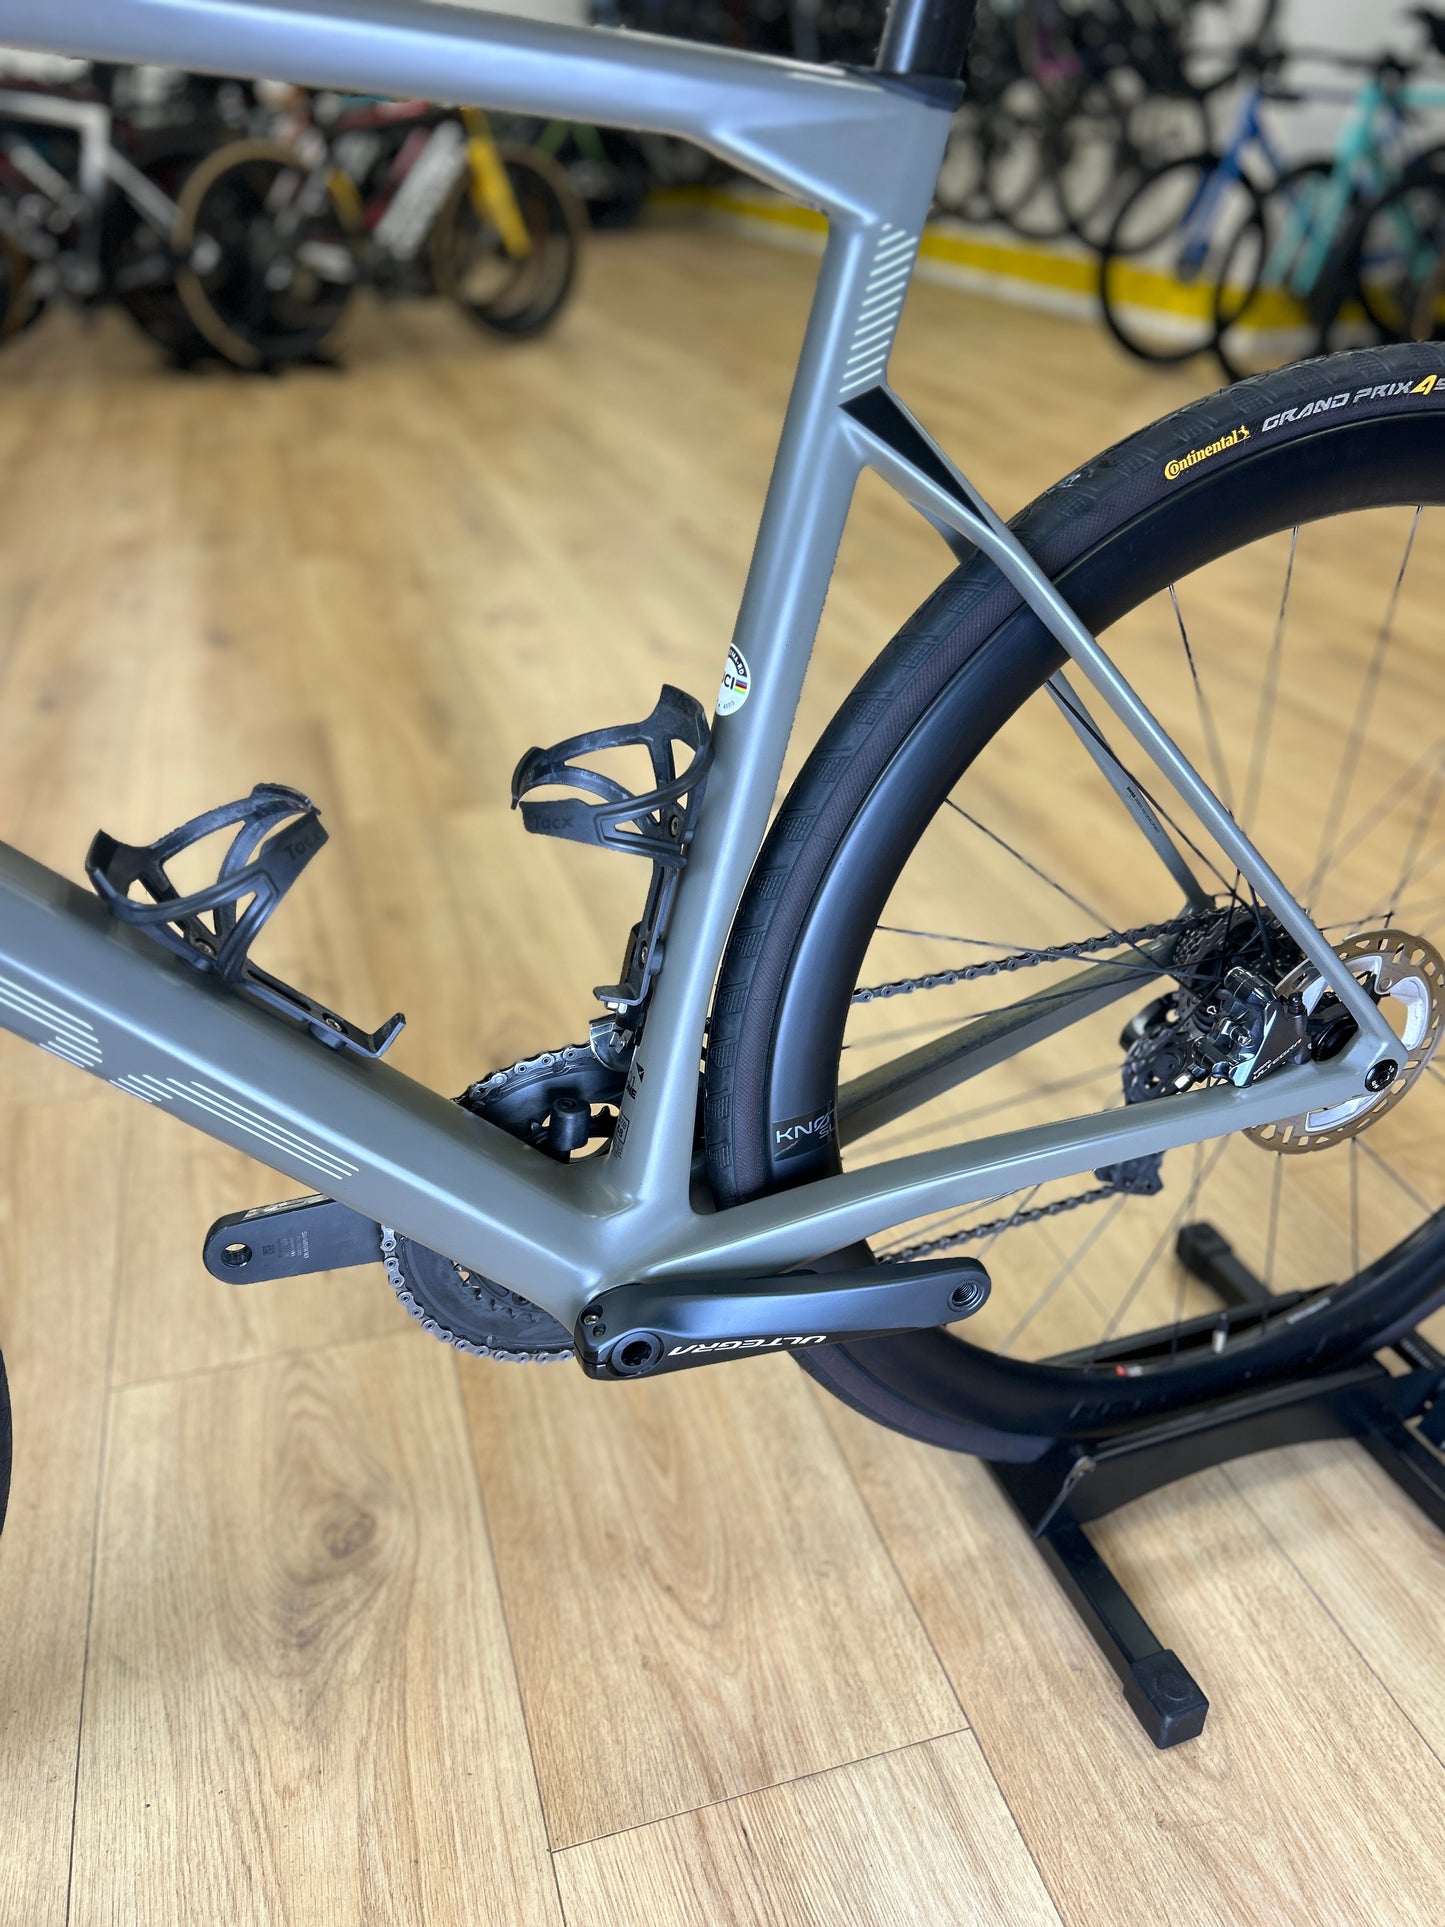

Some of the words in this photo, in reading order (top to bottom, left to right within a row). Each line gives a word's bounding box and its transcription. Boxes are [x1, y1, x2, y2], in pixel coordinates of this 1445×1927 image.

[1261, 392, 1350, 432] GRAND
[1164, 425, 1242, 480] Continental
[722, 673, 735, 690] CI
[667, 1335, 827, 1356] ULTEGRA
